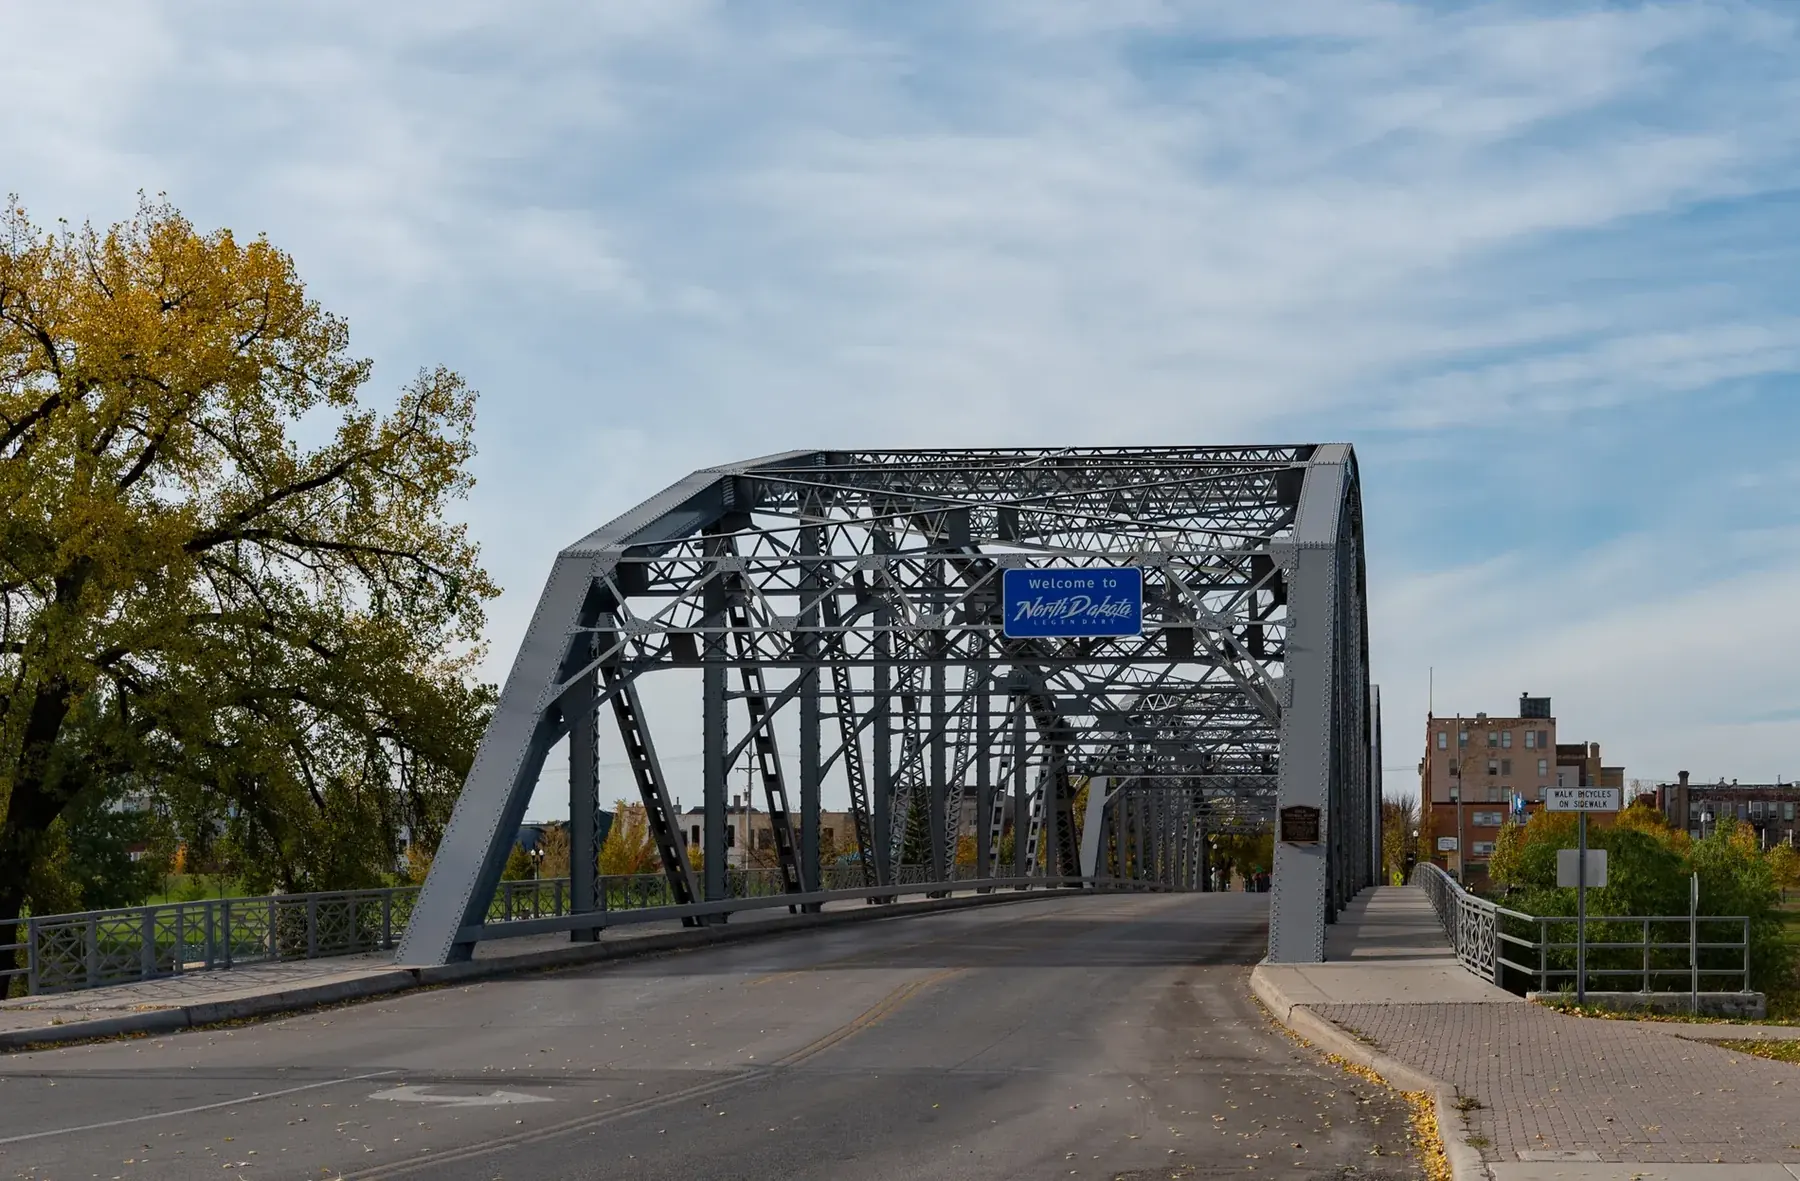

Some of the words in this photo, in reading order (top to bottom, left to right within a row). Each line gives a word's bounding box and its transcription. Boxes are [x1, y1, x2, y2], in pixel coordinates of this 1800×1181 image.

[1029, 578, 1095, 589] Welcome
[1103, 578, 1117, 588] to
[1013, 596, 1069, 622] North
[1060, 595, 1134, 619] Dakota
[1554, 790, 1573, 798] WALK
[1578, 790, 1612, 798] BICYCLES
[1559, 800, 1569, 808] ON
[1573, 800, 1608, 808] SIDEWALK
